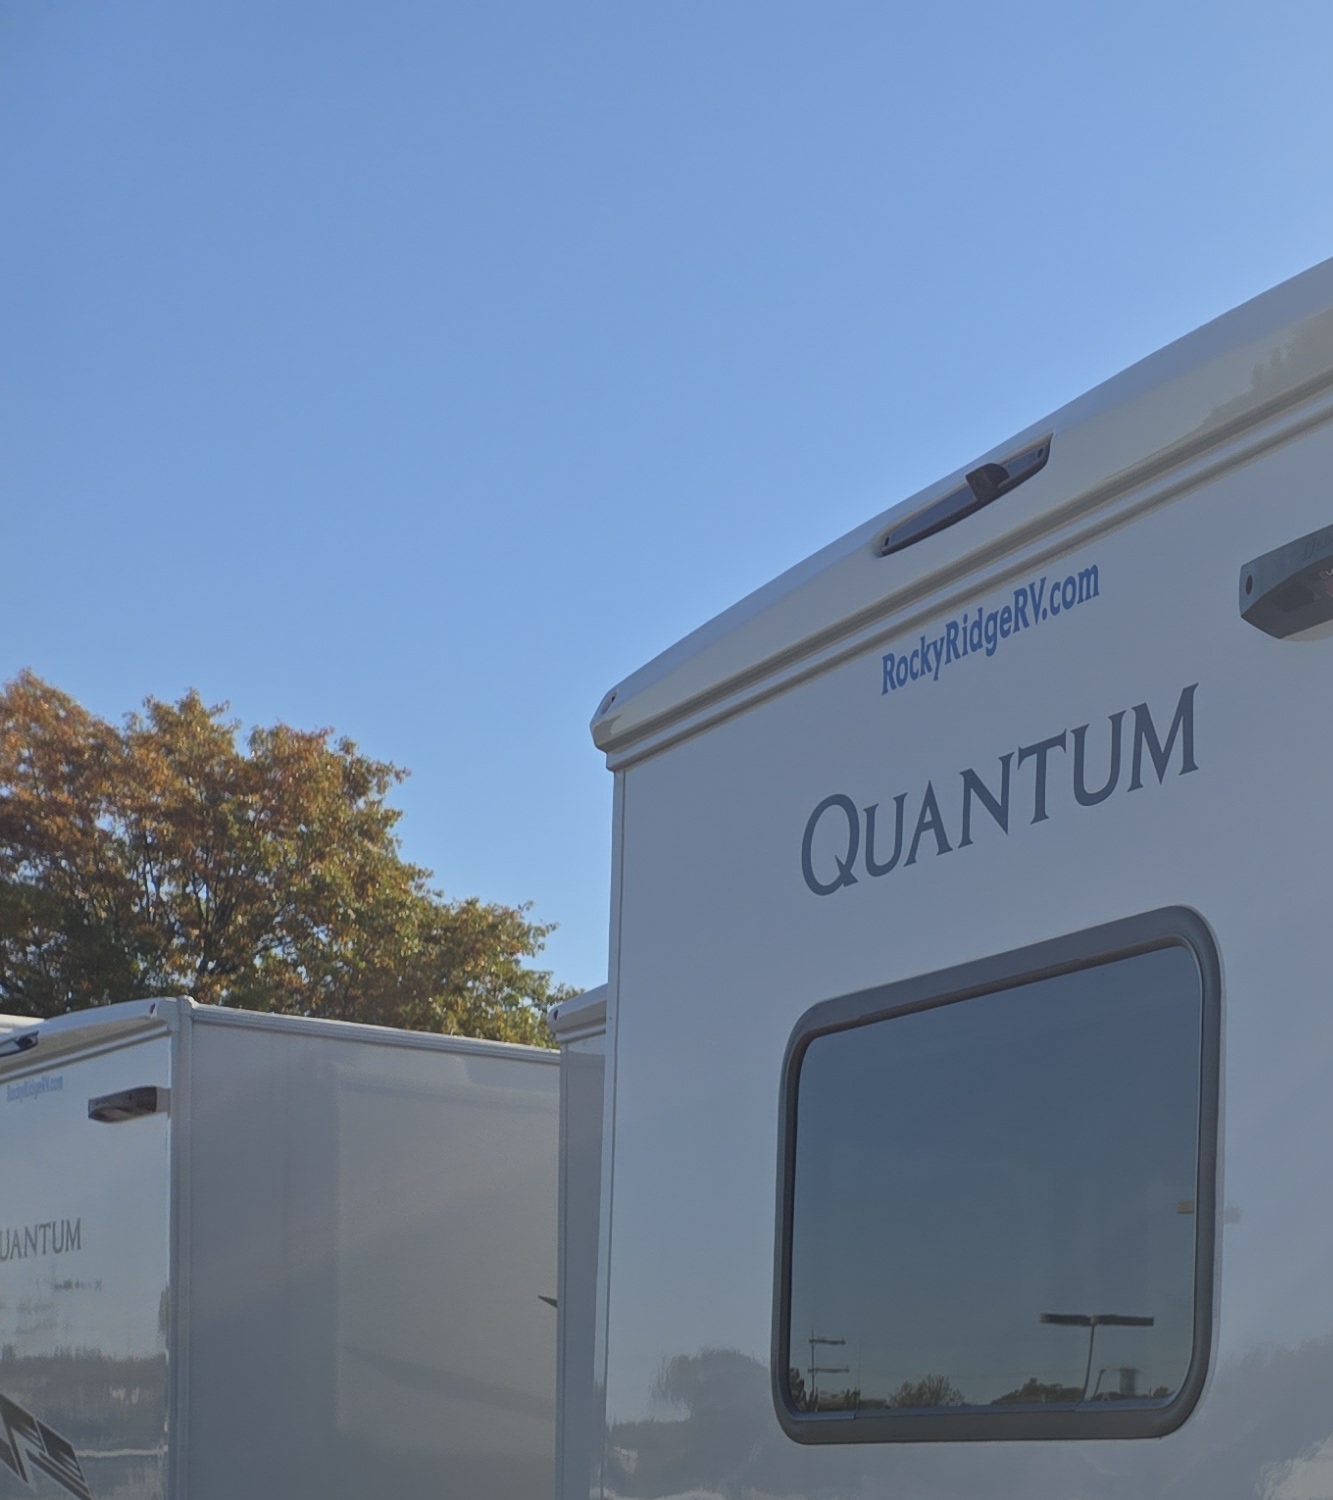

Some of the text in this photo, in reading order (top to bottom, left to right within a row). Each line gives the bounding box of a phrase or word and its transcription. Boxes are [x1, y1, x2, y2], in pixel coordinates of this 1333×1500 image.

[881, 564, 1100, 696] RockyRidgeRV.com
[801, 683, 1199, 896] QUANTUM
[0, 1218, 82, 1262] UANTUM
